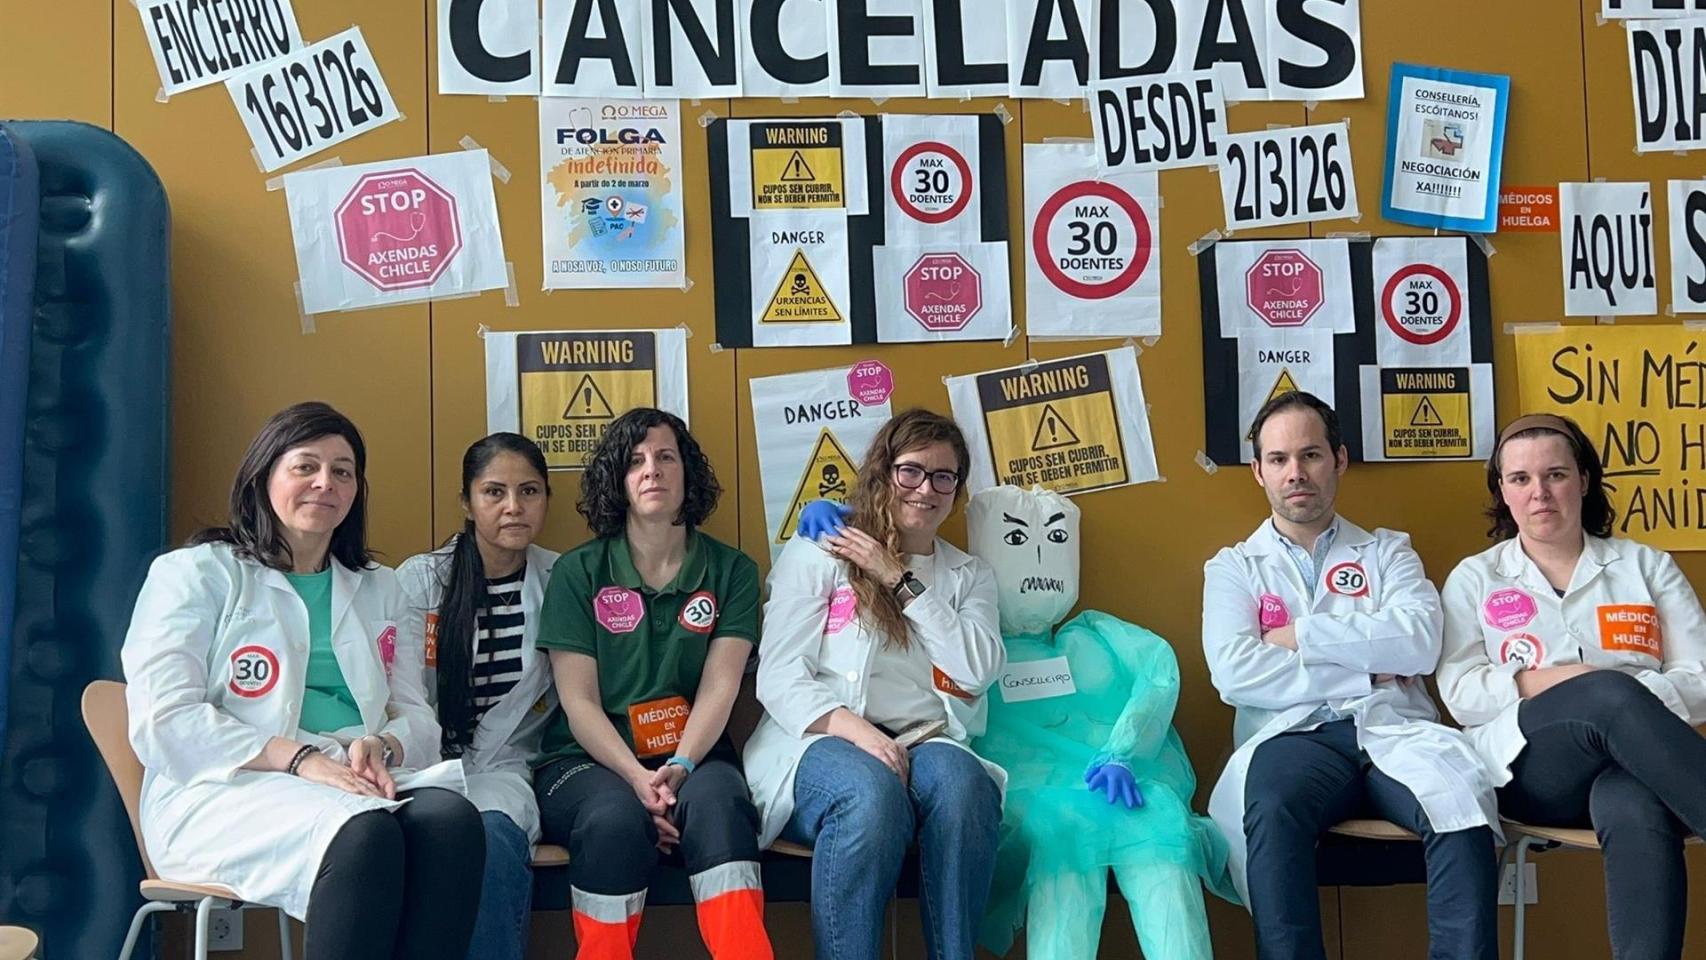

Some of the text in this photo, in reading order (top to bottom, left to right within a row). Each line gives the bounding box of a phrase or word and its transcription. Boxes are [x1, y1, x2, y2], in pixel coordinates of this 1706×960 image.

[149, 0, 290, 85] ENCIERRO
[449, 0, 1356, 89] CANCELADAS
[245, 39, 384, 158] 16/3/26
[1415, 89, 1481, 106] CONSELLERÍA,
[1415, 104, 1479, 120] ESCÓITANOS!
[1099, 79, 1218, 167] DESDE
[557, 128, 666, 144] FOLGA
[766, 127, 828, 145] WARNING
[561, 147, 574, 155] DE
[621, 147, 662, 155] PRIMARIA
[568, 156, 658, 175] indefinida
[920, 158, 943, 168] MAX
[1402, 160, 1481, 180] NEGOCIACIÓN
[574, 180, 650, 188] A partir do 2 de marzo
[914, 169, 949, 195] 30
[1226, 132, 1346, 222] 2/3/26
[763, 184, 787, 194] CUPOS
[789, 184, 803, 193] SEN
[361, 189, 427, 216] STOP
[758, 193, 840, 204] NON SE DEBEN PERMITIR
[909, 194, 954, 204] DOENTES
[1075, 206, 1109, 218] MAX
[1520, 206, 1531, 214] EN
[1502, 216, 1551, 226] HUELGA
[772, 231, 825, 244] DANGER
[1067, 221, 1118, 256] 30
[368, 244, 437, 266] AXENDAS
[1569, 192, 1655, 306] AQUÍ
[379, 260, 431, 278] CHICLE
[552, 260, 559, 273] A
[561, 260, 585, 273] NOSA
[610, 260, 618, 272] O
[620, 260, 643, 272] NOSO
[645, 259, 678, 272] FUTURO
[1060, 258, 1124, 270] DOENTES
[1263, 263, 1304, 277] STOP
[921, 267, 963, 281] STOP
[1410, 281, 1433, 290] MAX
[776, 296, 826, 306] URXENCIAS
[1263, 300, 1308, 310] AXENDAS
[1405, 291, 1439, 315] 30
[775, 308, 793, 317] SEN
[921, 304, 966, 314] AXENDAS
[1270, 310, 1303, 319] CHICLE
[927, 314, 961, 323] CHICLE
[1401, 316, 1443, 325] DOENTES
[541, 339, 634, 365] WARNING
[1259, 351, 1311, 363] DANGER
[857, 366, 882, 378] STOP
[1641, 340, 1706, 409] MÉ
[1000, 365, 1089, 401] WARNING
[1396, 373, 1456, 390] WARNING
[784, 400, 862, 424] DANGER
[536, 425, 572, 439] CUPOS
[575, 424, 596, 437] SEN
[1393, 429, 1416, 438] CUPOS
[1418, 429, 1432, 438] SEN
[536, 440, 549, 453] ON
[552, 440, 565, 453] SE
[1389, 440, 1402, 448] NON
[1436, 439, 1467, 448] PERMITIR
[1602, 420, 1660, 468] NO
[1009, 456, 1044, 474] CUPOS
[1044, 452, 1066, 468] SEN
[1025, 471, 1039, 485] SE
[1041, 465, 1072, 482] DEBEN
[1073, 457, 1120, 477] PERMITIR
[1335, 570, 1364, 589] 30
[602, 592, 629, 604] STOP
[1492, 593, 1521, 607] STOP
[686, 599, 712, 622] 30
[1634, 624, 1646, 633] EN
[235, 659, 269, 681] 30
[637, 705, 690, 725] MÉDICOS
[664, 721, 675, 730] EN
[646, 731, 681, 749] HUEL
